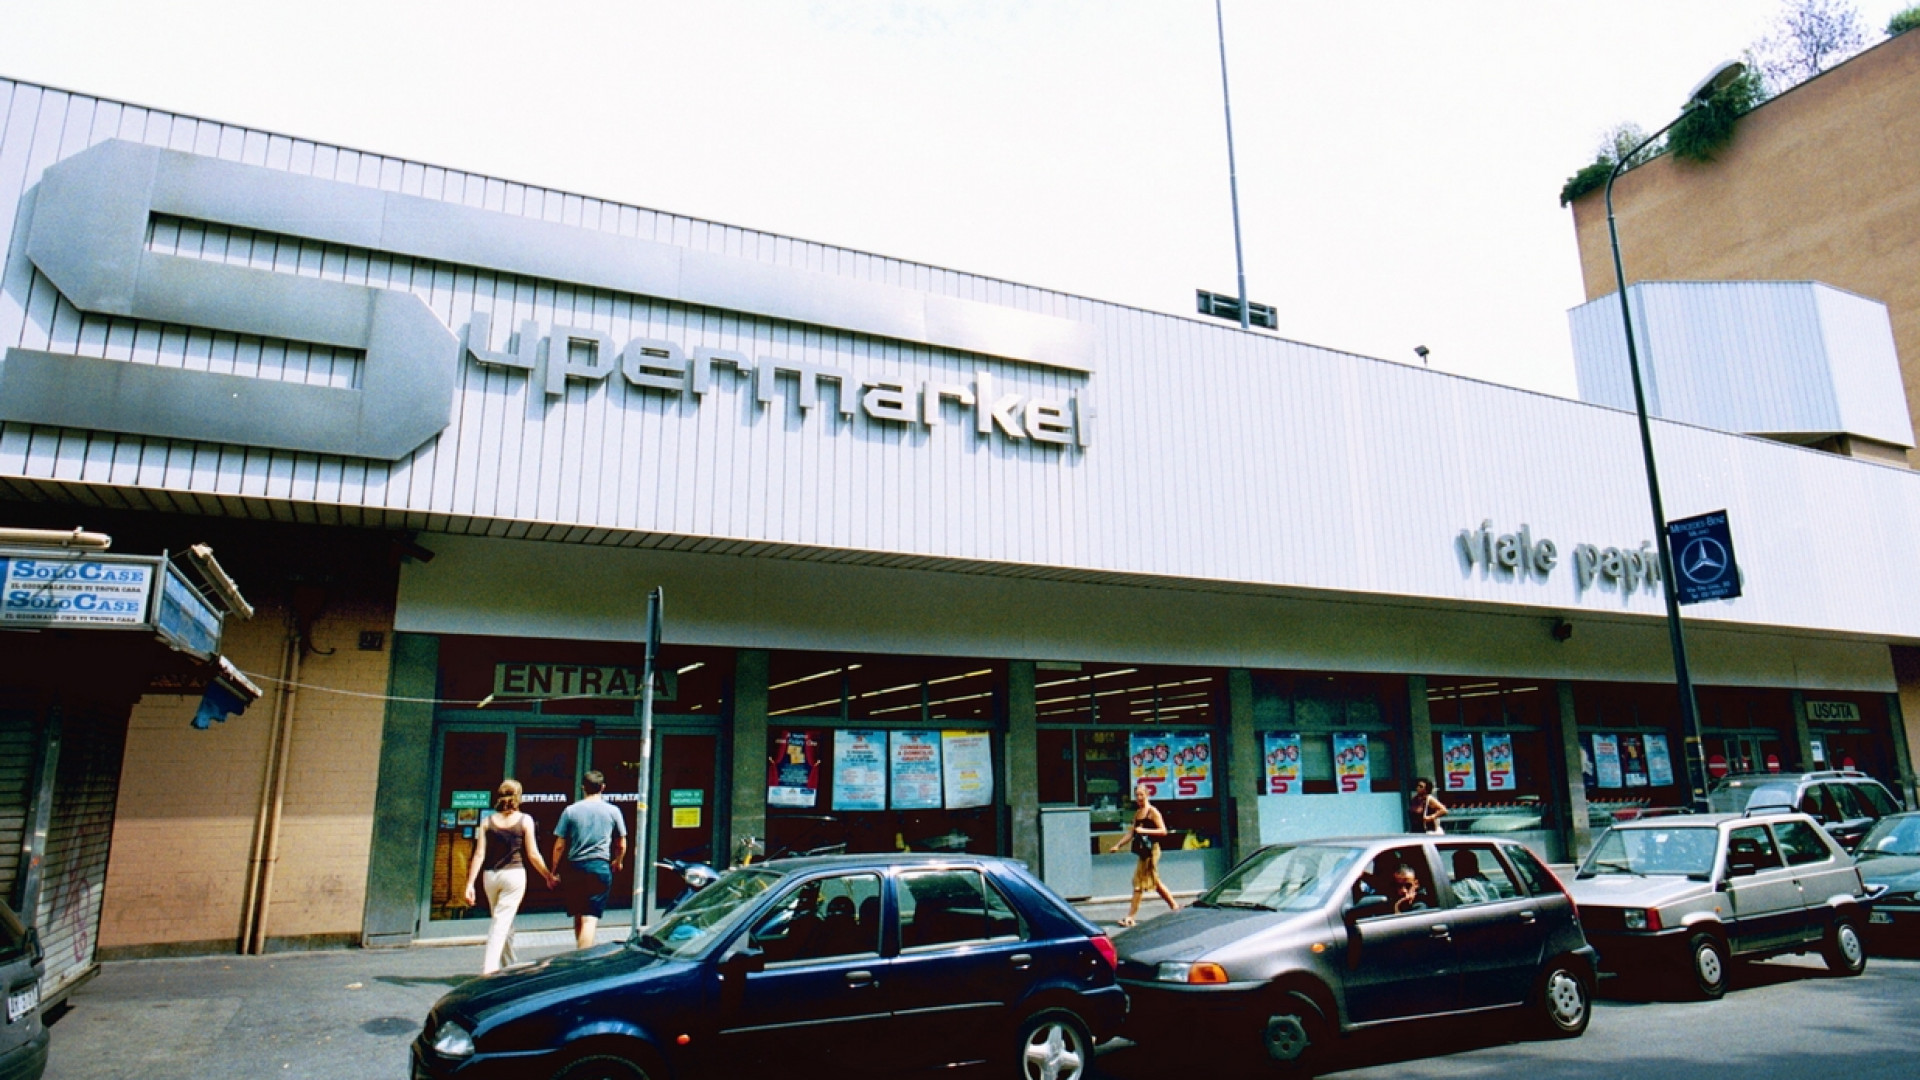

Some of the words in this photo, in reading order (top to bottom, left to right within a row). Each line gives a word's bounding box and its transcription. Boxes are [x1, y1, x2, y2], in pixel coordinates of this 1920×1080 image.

[1458, 518, 1557, 573] viale
[503, 664, 669, 697] ENTRATA
[1813, 703, 1854, 719] USCITA
